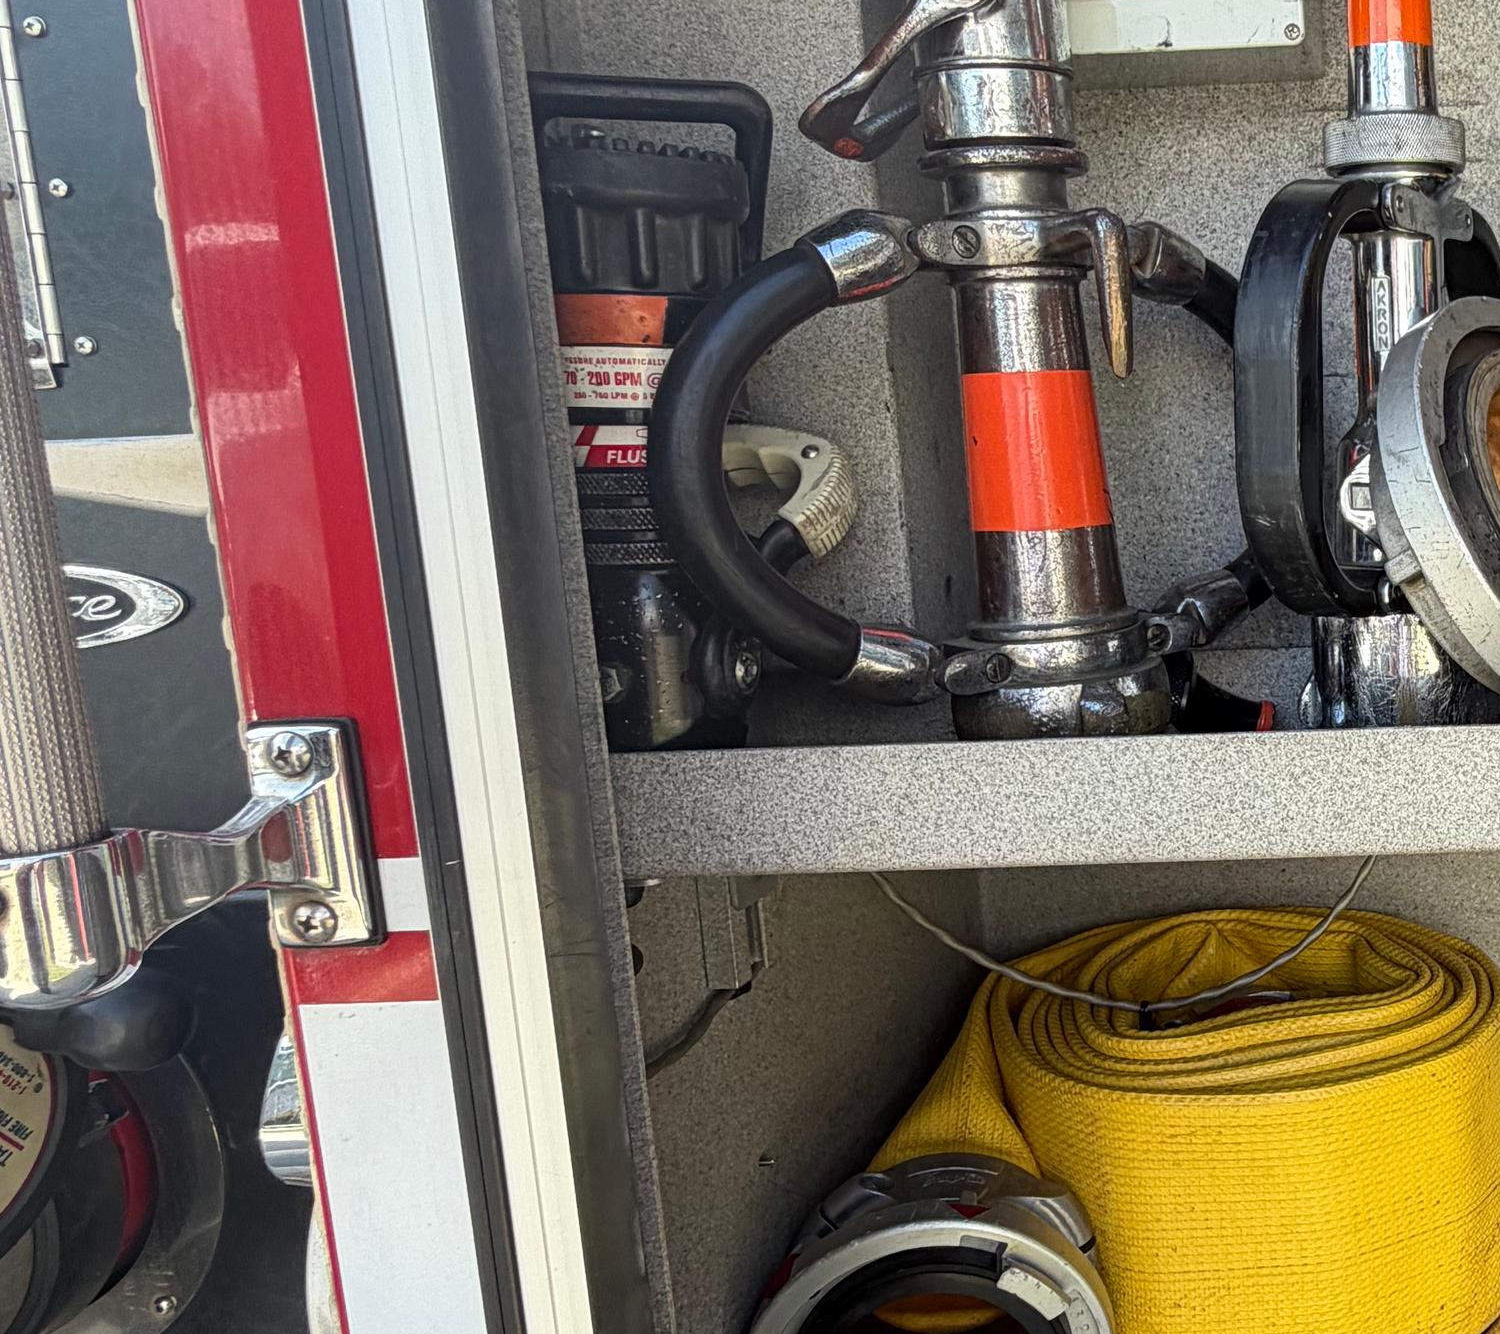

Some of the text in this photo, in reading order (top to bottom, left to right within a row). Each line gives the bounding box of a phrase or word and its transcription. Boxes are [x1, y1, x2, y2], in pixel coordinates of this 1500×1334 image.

[1376, 279, 1389, 349] AKRON
[595, 356, 667, 366] AUTOMATICALLY
[586, 371, 611, 386] 200
[614, 371, 642, 387] GPM
[611, 392, 628, 400] LPM
